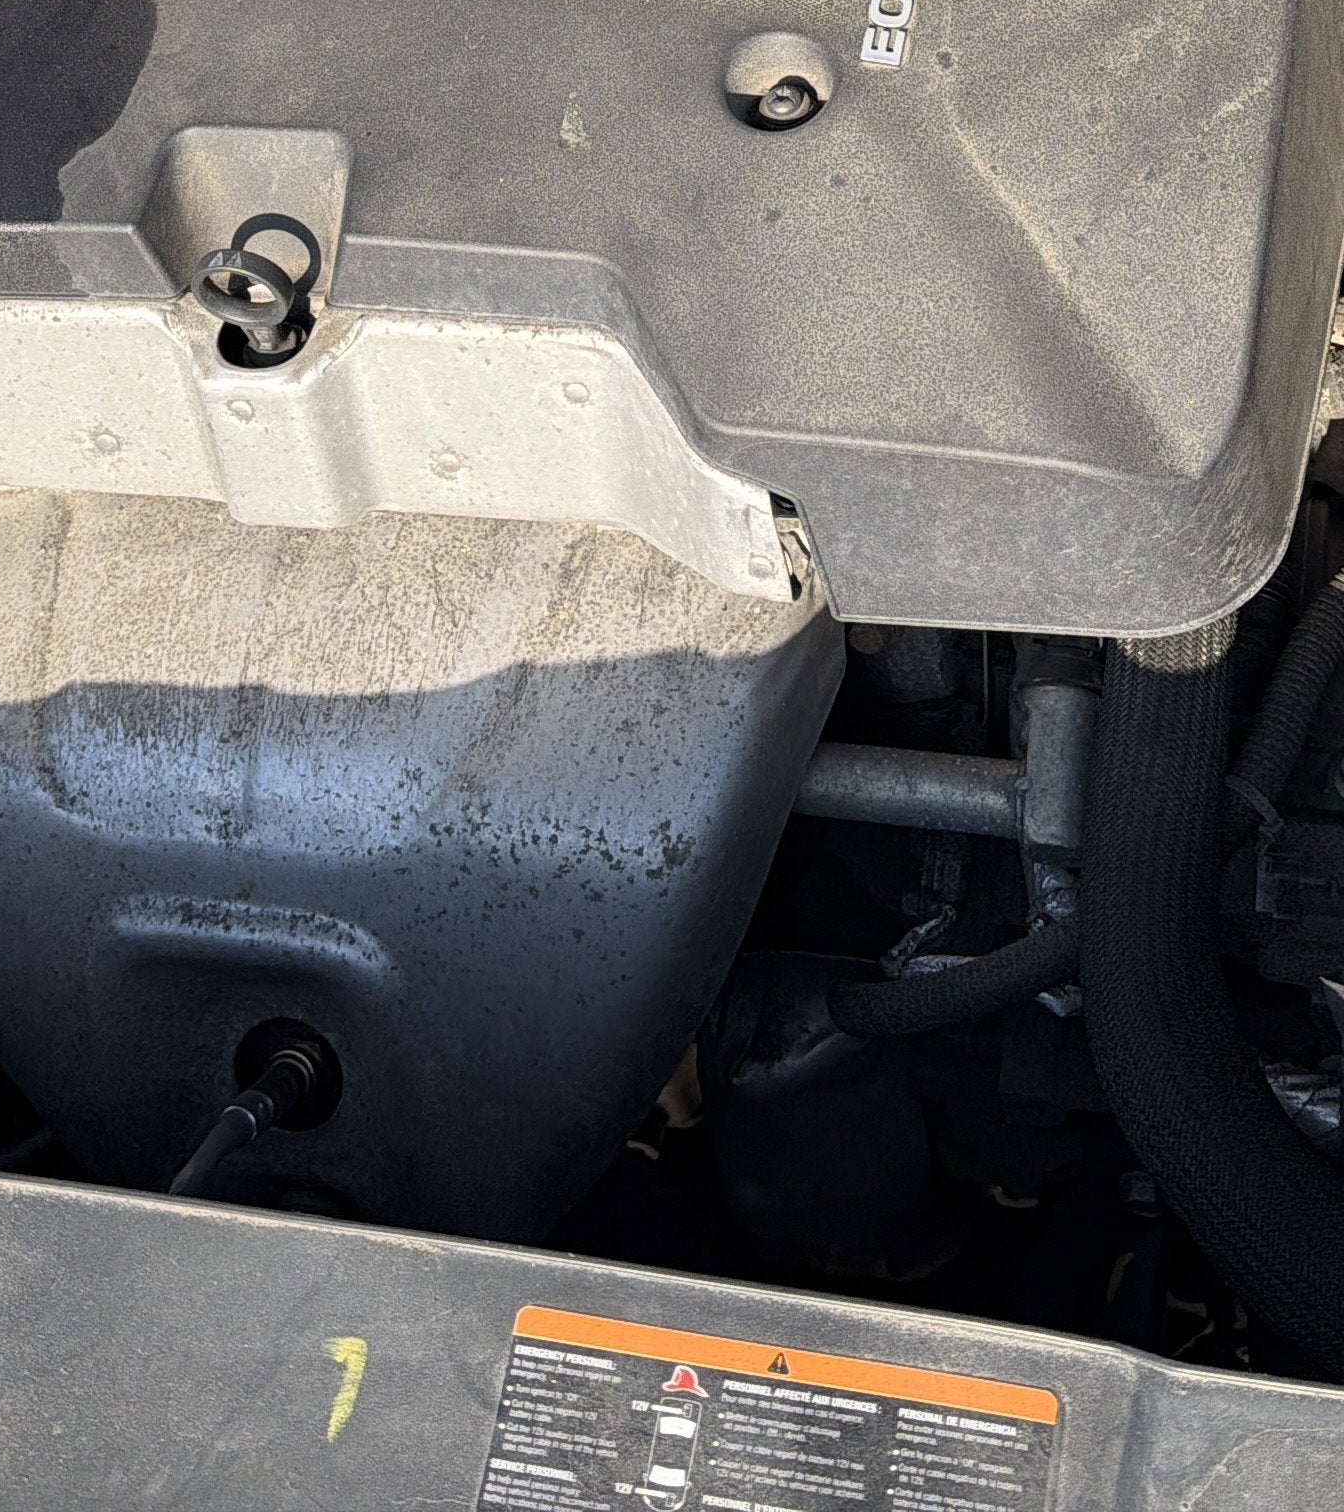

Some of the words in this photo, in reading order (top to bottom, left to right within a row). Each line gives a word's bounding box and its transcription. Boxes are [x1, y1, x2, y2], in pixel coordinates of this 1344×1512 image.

[514, 1344, 565, 1362] EMERGENCY
[566, 1354, 617, 1371] PERSONNEL:
[631, 1400, 649, 1412] 12V
[723, 1380, 772, 1396] PERSONNEL
[812, 1394, 830, 1405] AUX
[832, 1397, 877, 1413] URGENCES
[898, 1408, 945, 1424] PERSONAL
[946, 1416, 958, 1426] DE
[960, 1418, 1017, 1436] EMERGENCIA
[490, 1458, 525, 1472] SERVICE
[526, 1465, 577, 1482] PERSONNEL:
[615, 1482, 633, 1495] 12V
